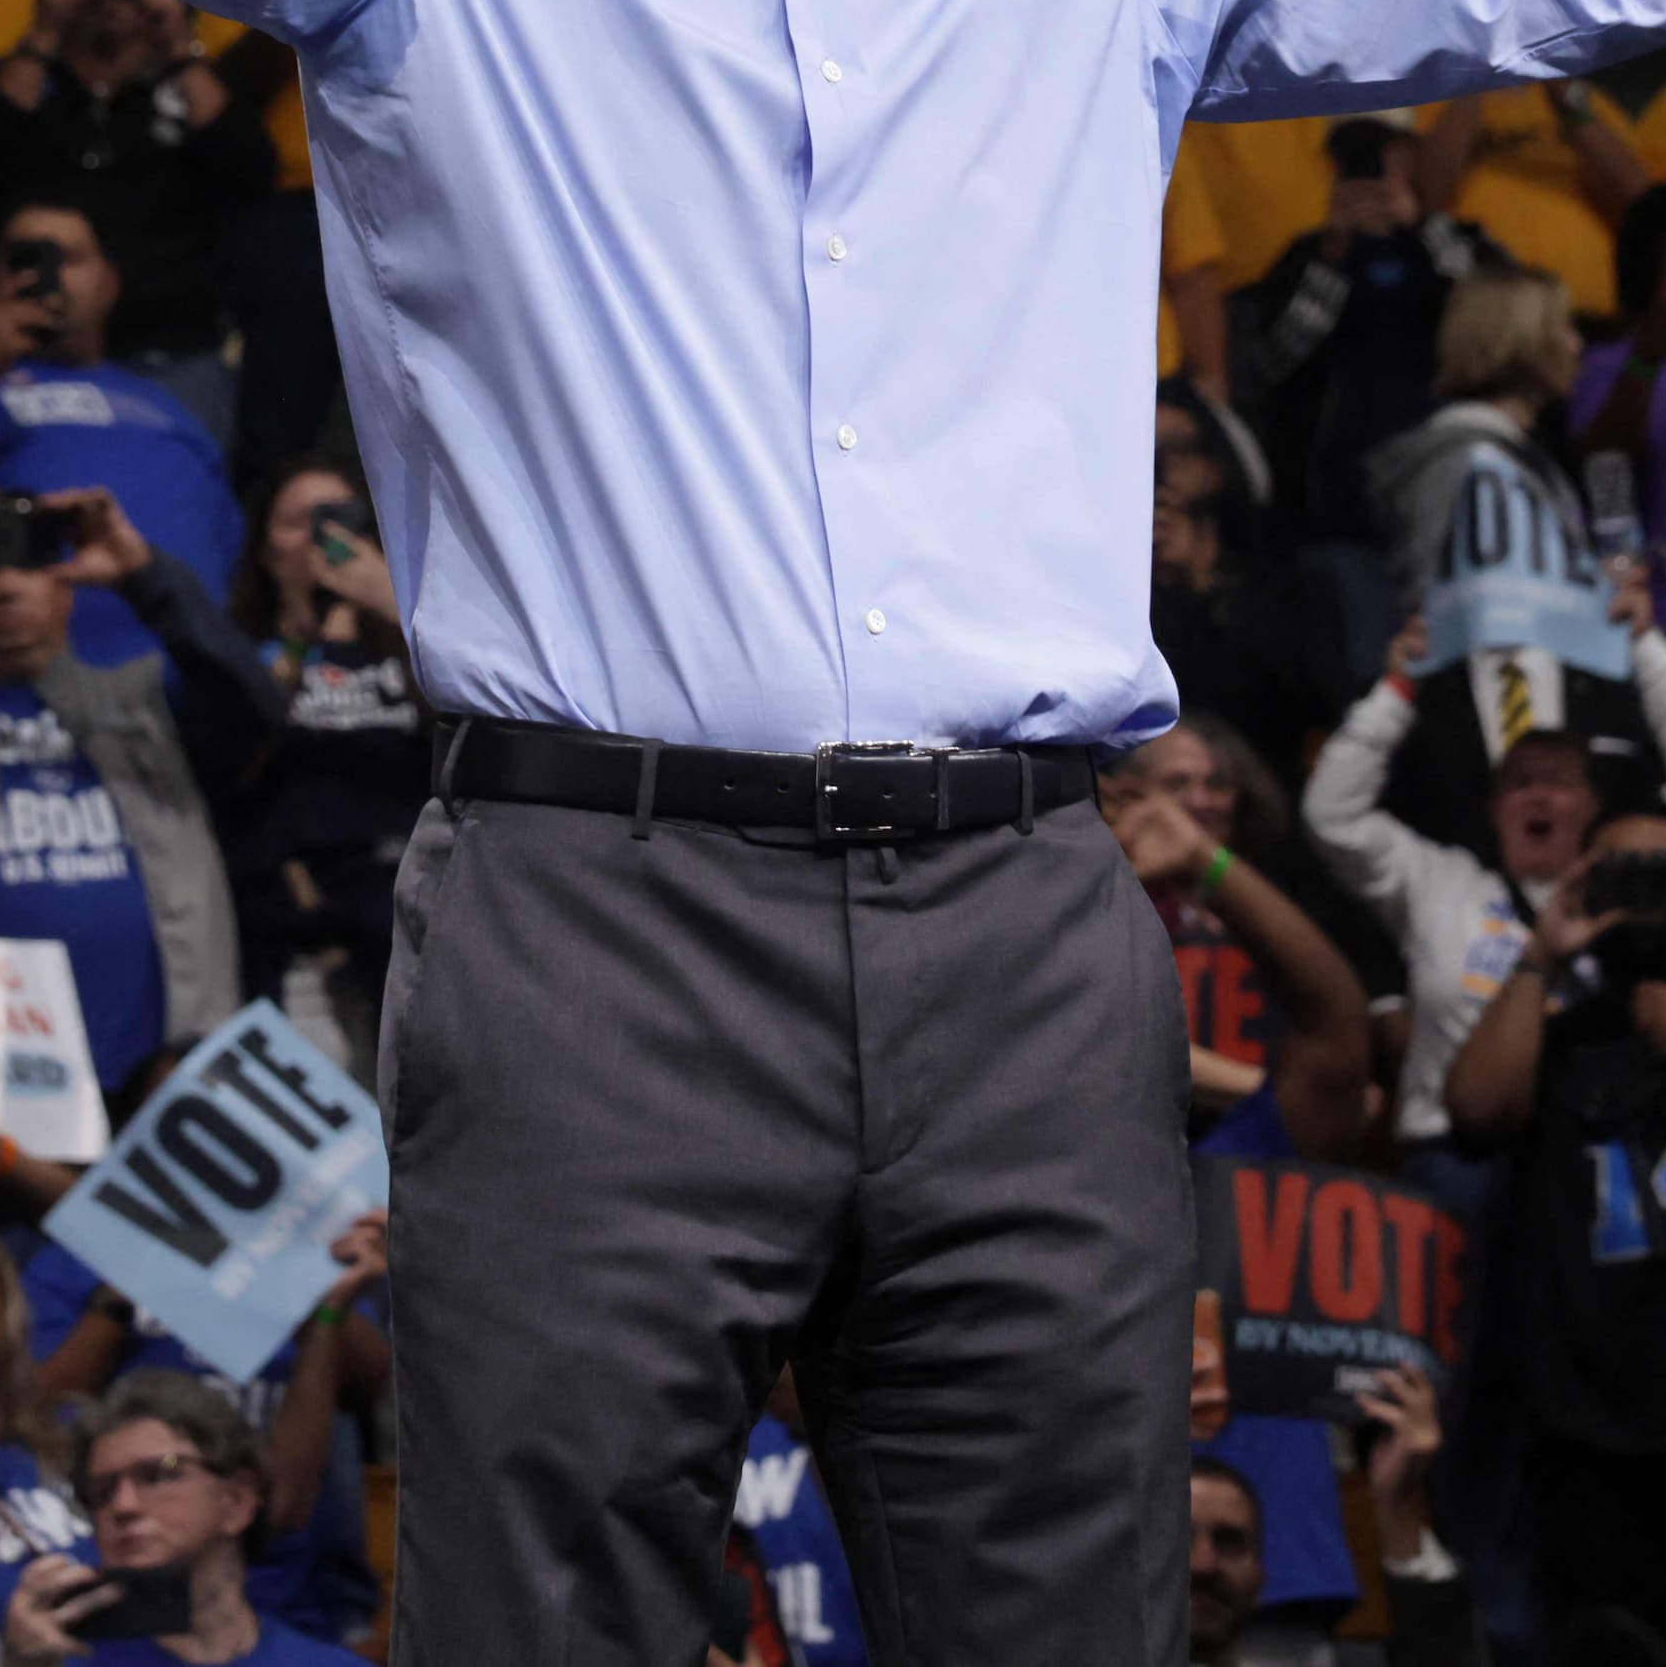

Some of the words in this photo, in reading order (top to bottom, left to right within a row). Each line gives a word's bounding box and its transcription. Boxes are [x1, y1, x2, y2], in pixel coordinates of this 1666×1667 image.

[91, 1025, 354, 1271] VOTE
[1233, 1168, 1470, 1368] VOTE
[1235, 1316, 1279, 1351] BY
